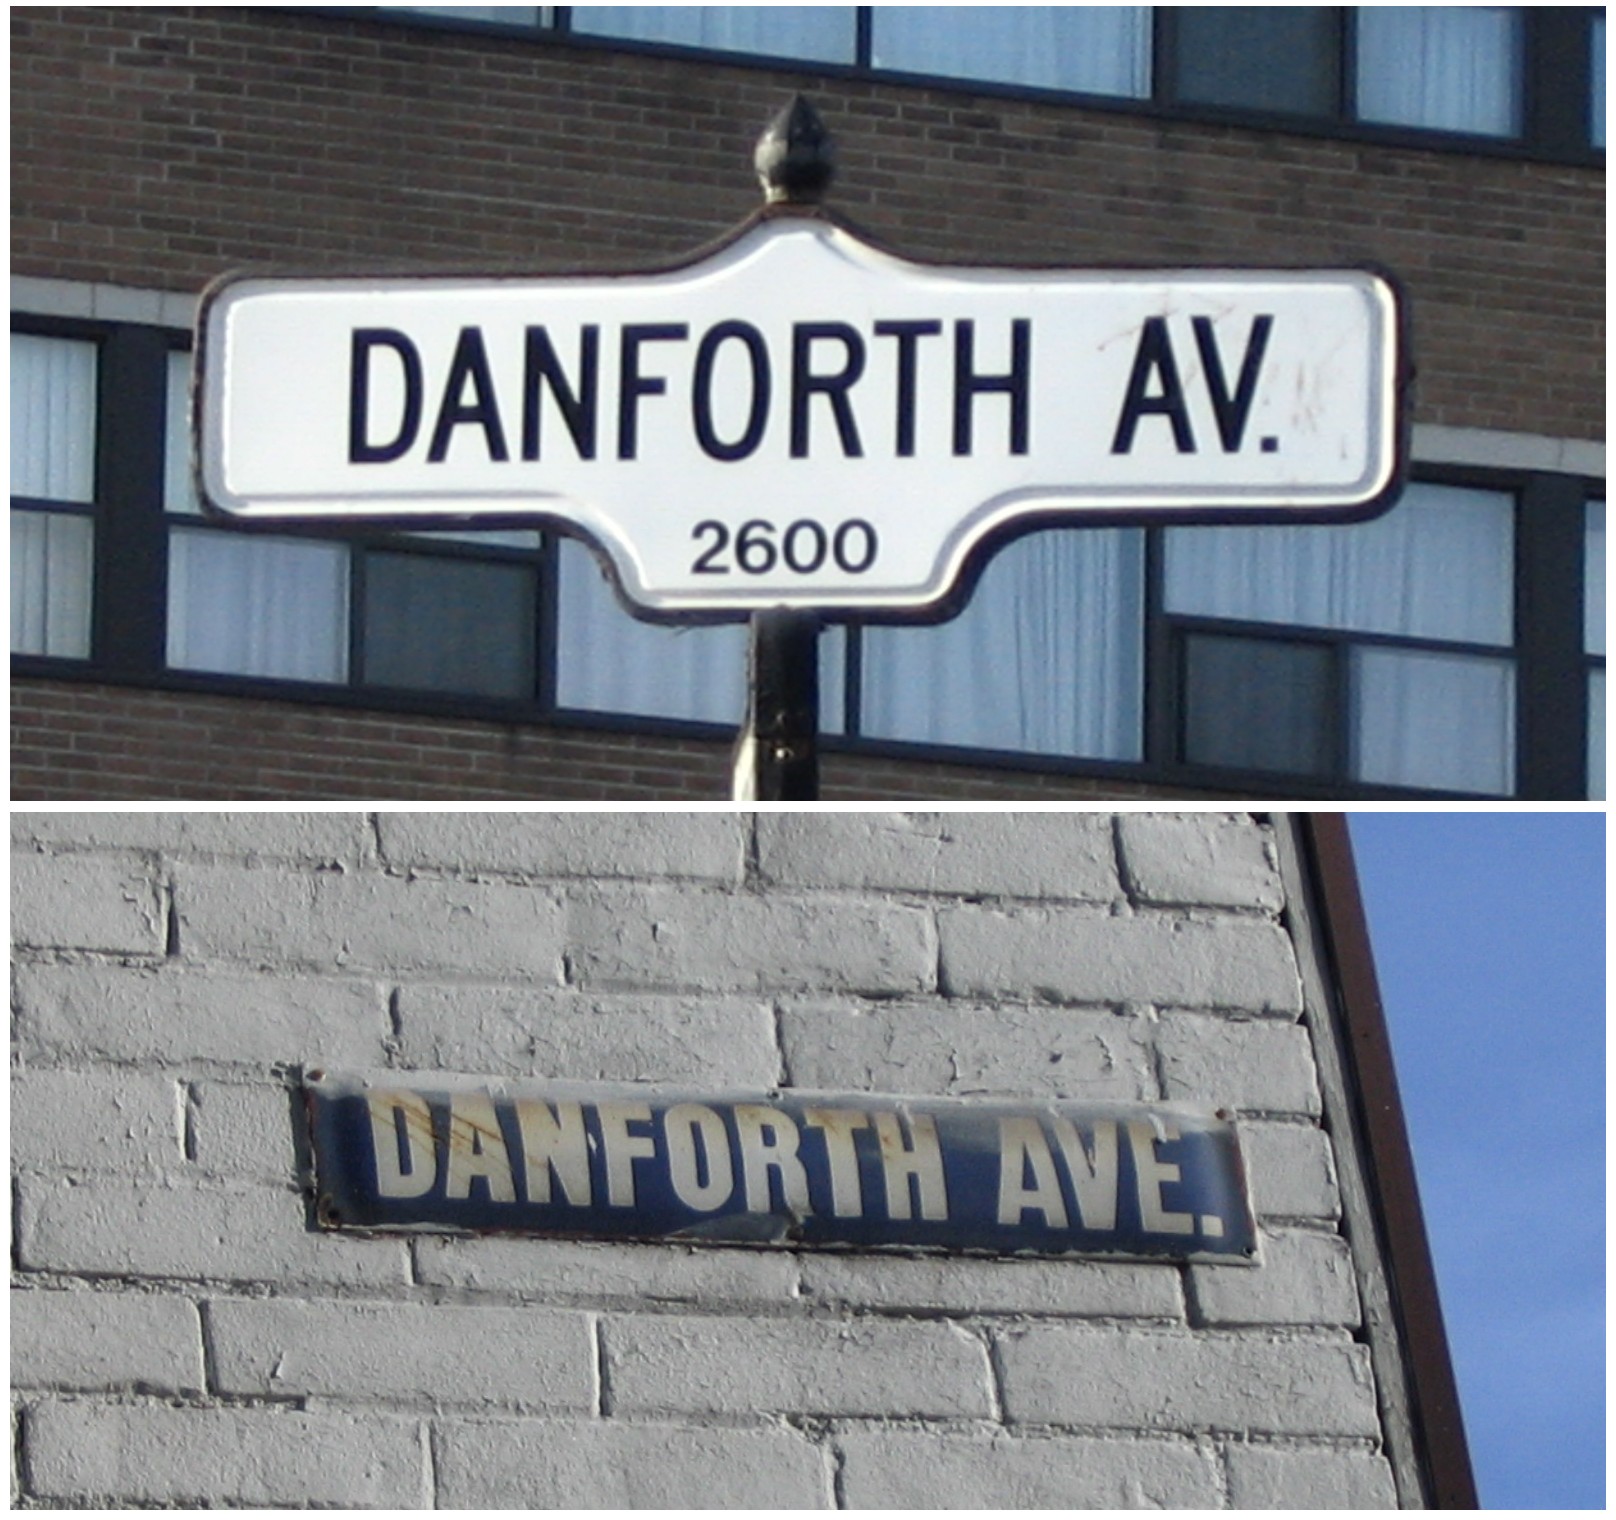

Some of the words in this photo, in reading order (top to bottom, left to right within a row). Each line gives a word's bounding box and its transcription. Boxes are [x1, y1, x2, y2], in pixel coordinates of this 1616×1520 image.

[348, 318, 1031, 463] DANFORTH
[1110, 314, 1280, 456] AV.
[690, 518, 880, 576] 2600
[367, 1090, 949, 1221] DANFORTH
[998, 1116, 1224, 1238] AVE.
